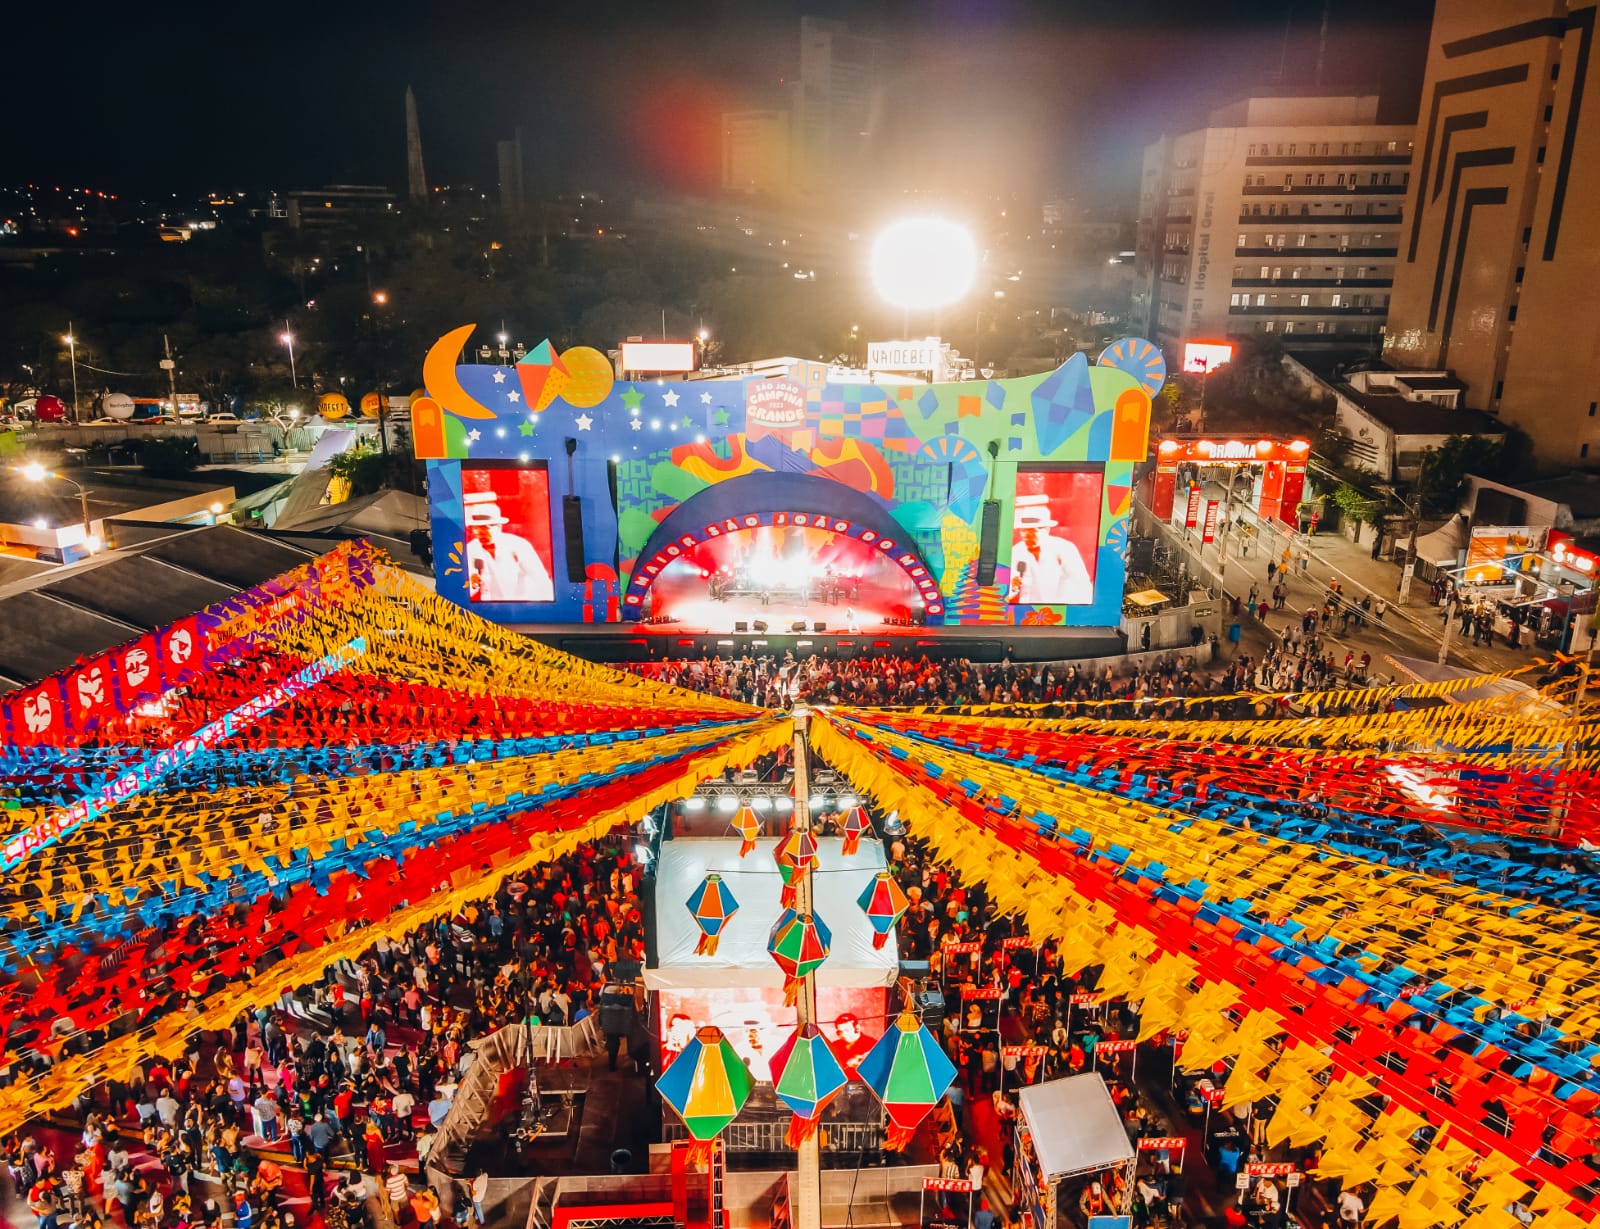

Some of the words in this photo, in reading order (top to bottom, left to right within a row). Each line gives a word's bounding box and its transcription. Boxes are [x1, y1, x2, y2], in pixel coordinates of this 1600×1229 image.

[1201, 191, 1215, 229] Geral
[1194, 233, 1210, 290] Hospital
[872, 349, 936, 365] VAIDEBET
[749, 390, 804, 408] CAMPINA
[755, 382, 773, 392] SÃO
[776, 383, 799, 394] JOÃO
[747, 405, 805, 422] GRANDE
[1209, 443, 1257, 459] BRAHMA
[1187, 490, 1200, 522] BRAHMA
[1204, 504, 1218, 537] BRAHMA
[626, 596, 640, 604] O
[634, 537, 697, 586] MAIOR
[708, 517, 758, 536] SÃO
[777, 514, 848, 532] JOÃO
[862, 531, 893, 549] DO
[899, 555, 941, 613] MUNDO
